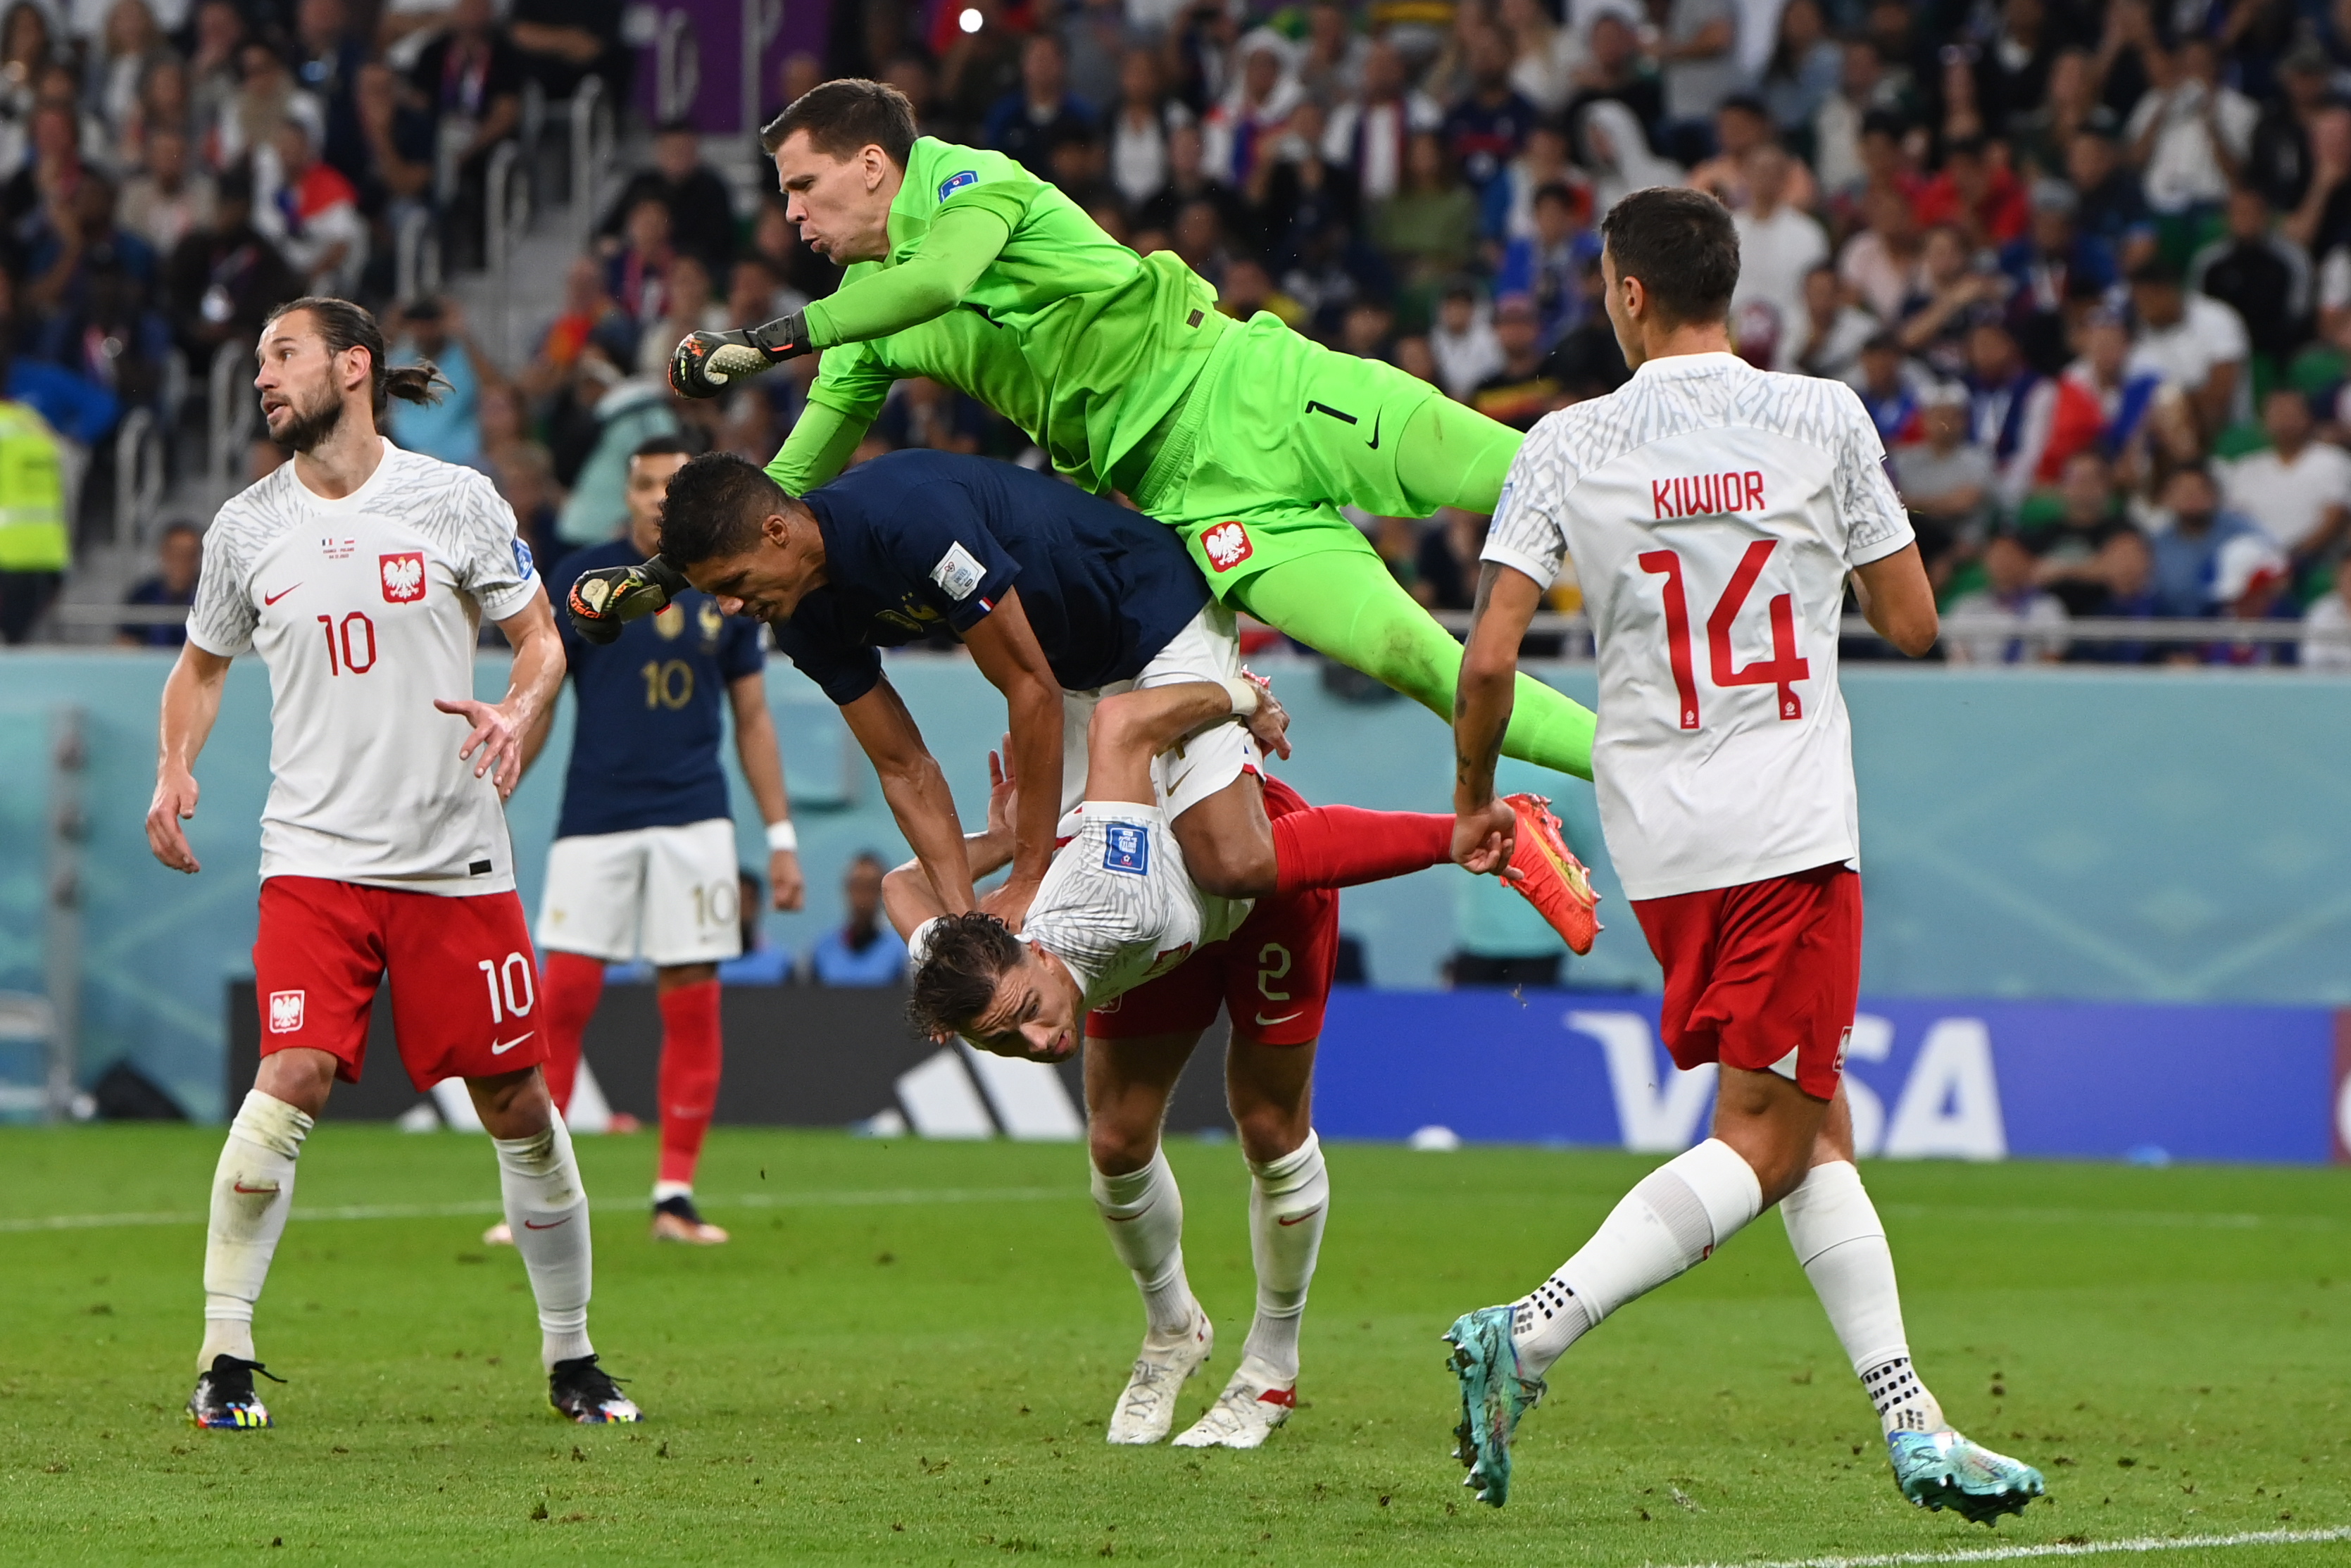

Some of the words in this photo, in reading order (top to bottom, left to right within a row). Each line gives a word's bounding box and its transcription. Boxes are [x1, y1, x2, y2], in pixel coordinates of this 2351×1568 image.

[1305, 400, 1358, 425] 1
[1652, 470, 1766, 519] KIWIOR
[317, 610, 377, 677] 10
[1638, 539, 1810, 729] 14
[642, 660, 694, 710] 10
[691, 880, 739, 928] 10
[478, 951, 534, 1024] 10
[1258, 942, 1291, 1001] 2
[1566, 1011, 2008, 1159] VSA
